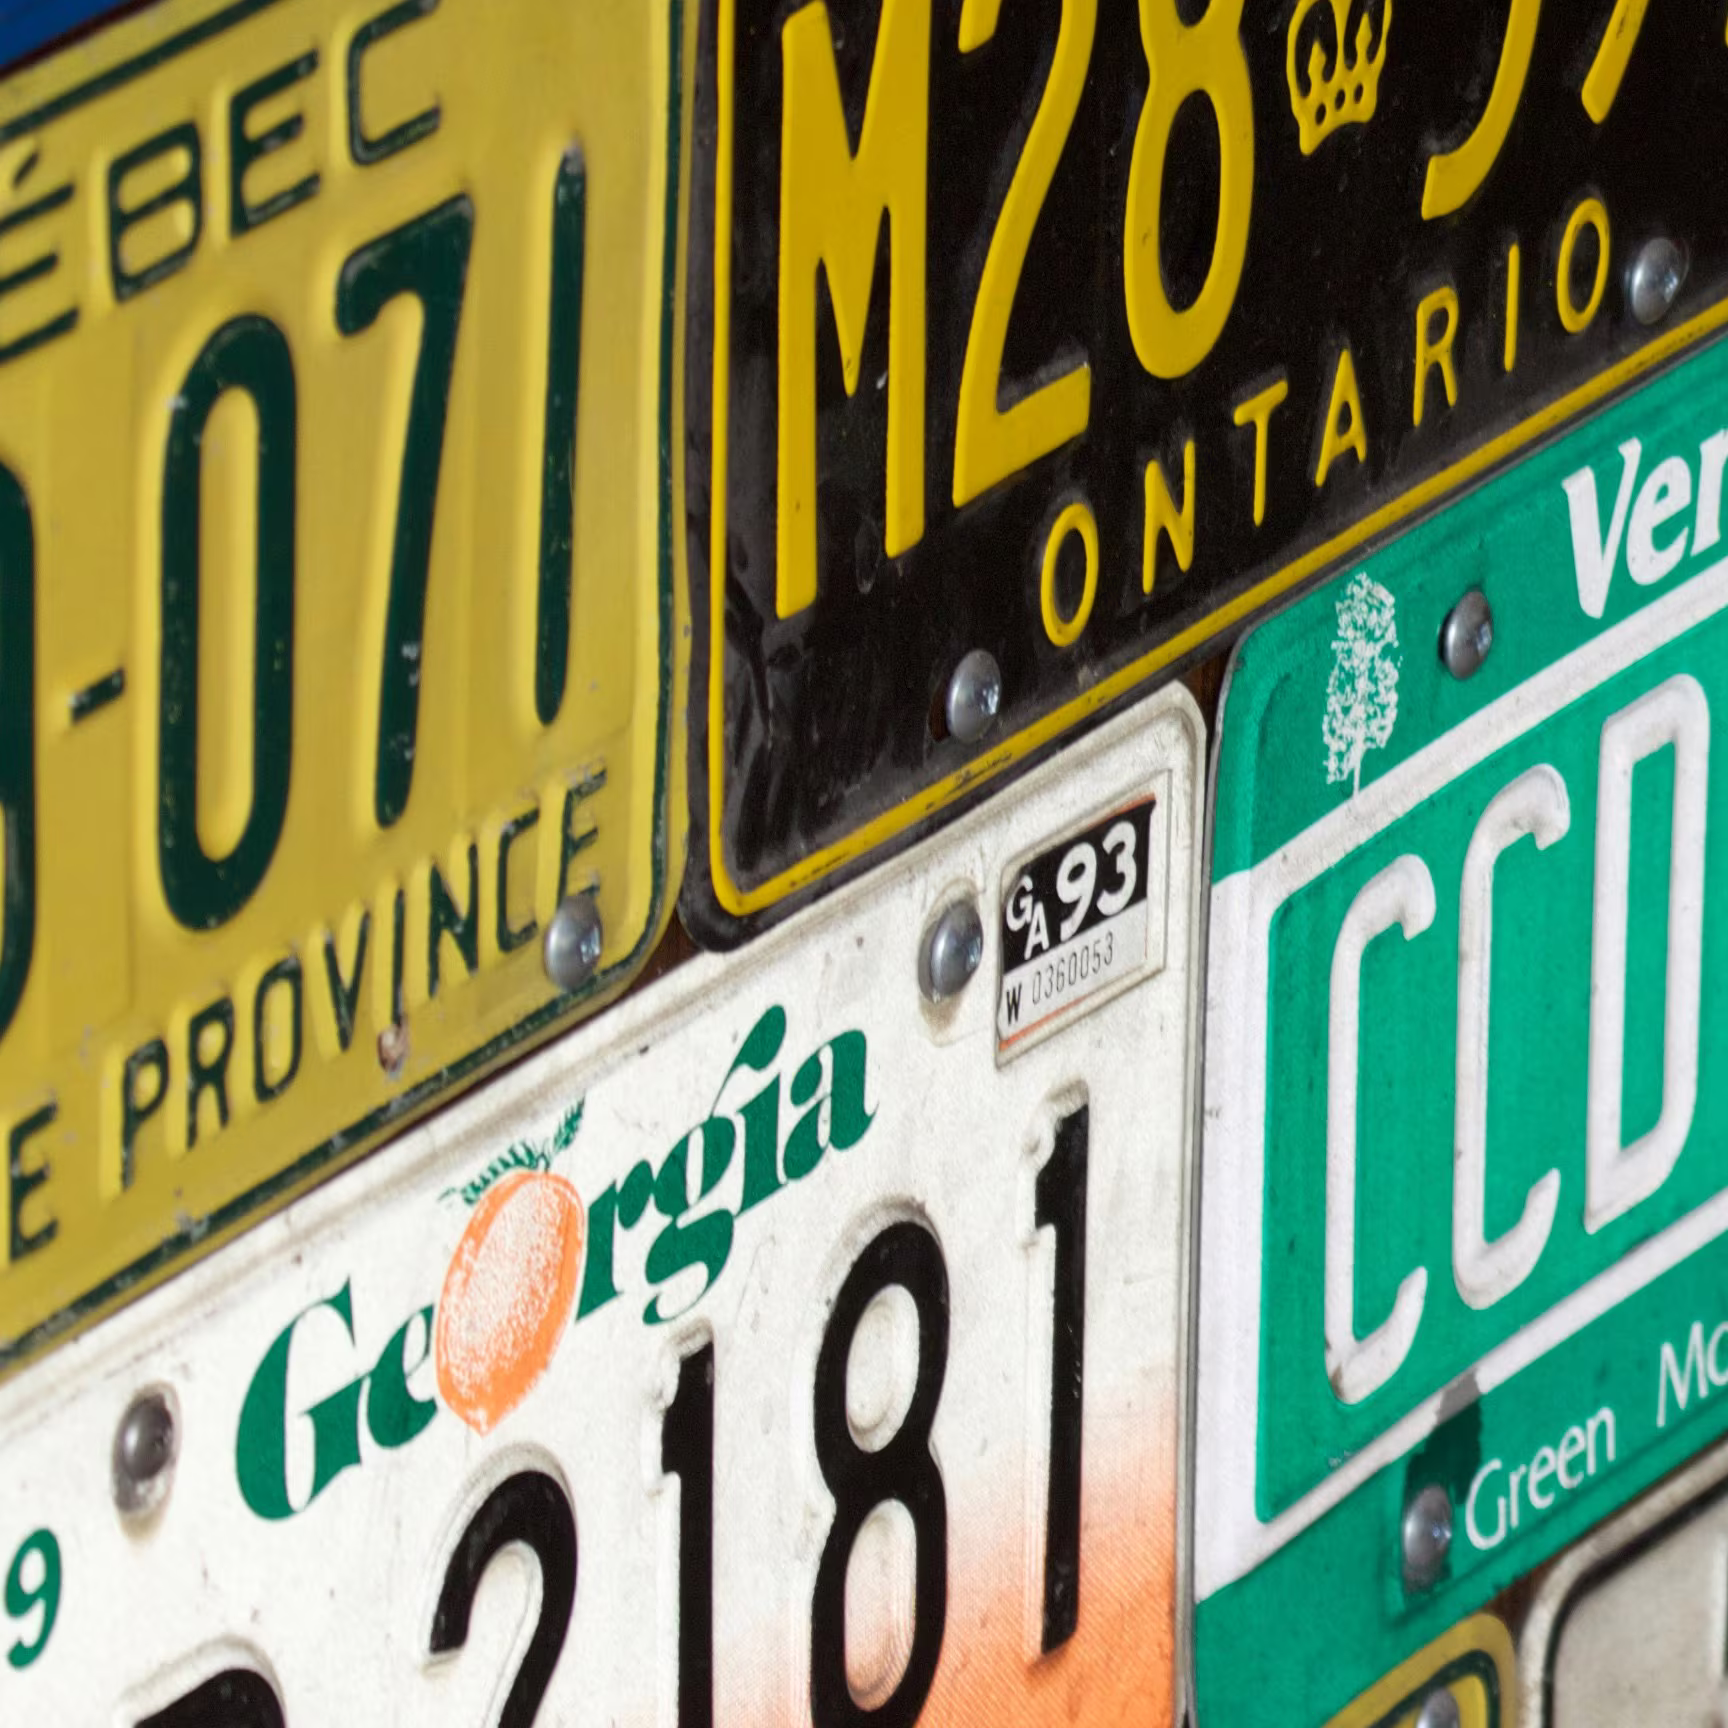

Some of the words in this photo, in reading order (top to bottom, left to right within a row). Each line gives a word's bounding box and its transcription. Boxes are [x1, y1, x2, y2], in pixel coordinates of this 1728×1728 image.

[0, 136, 588, 1047] -071
[1040, 197, 1611, 648] ONTARIO
[121, 768, 608, 1191] PROVINCE
[1005, 982, 1023, 1025] W
[1031, 930, 1115, 1006] 0360053
[1055, 820, 1138, 943] 93
[1323, 672, 1713, 1406] CCD
[1464, 1405, 1616, 1552] Green
